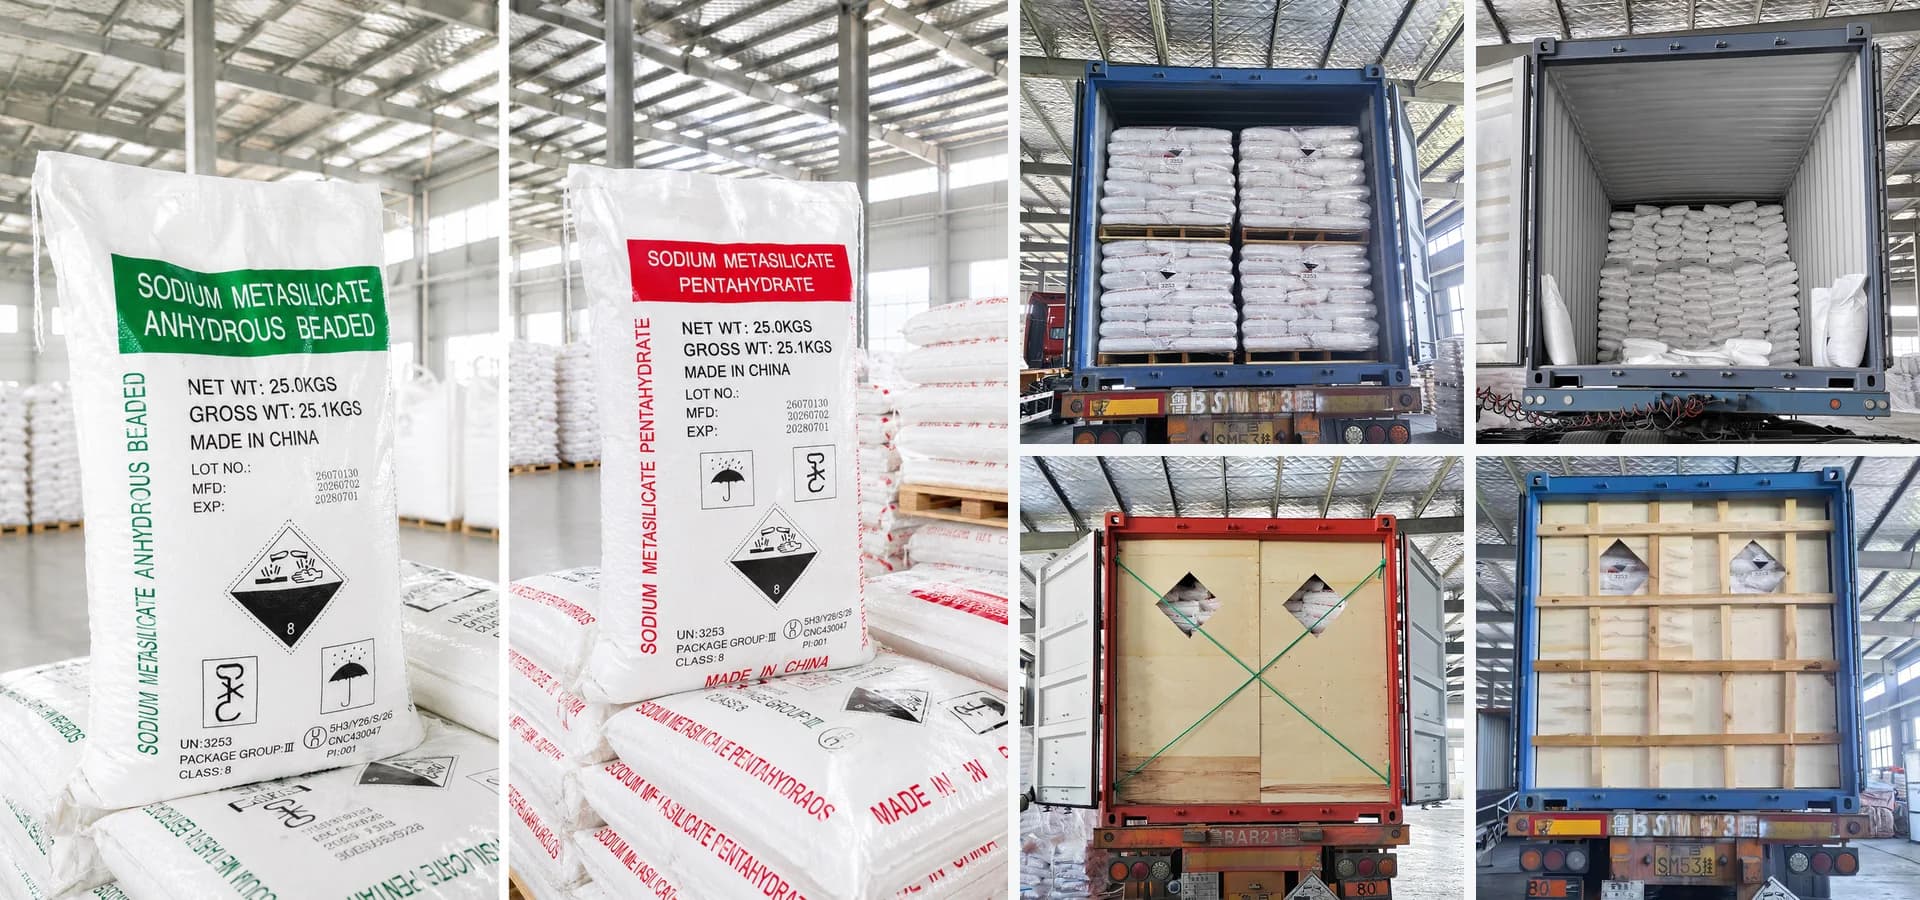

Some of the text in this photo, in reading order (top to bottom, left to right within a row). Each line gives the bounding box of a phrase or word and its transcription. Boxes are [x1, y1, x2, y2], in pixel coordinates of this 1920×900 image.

[648, 250, 836, 269] SODIUM METASILICATE
[137, 272, 373, 310] SODIUM METASILICATE
[679, 277, 815, 293] PENTAHYDRATE
[144, 309, 376, 343] ANHYDROUS BEADED
[682, 320, 813, 335] NET WT: 25.0KGS
[683, 340, 833, 357] GROSS WT: 25.1KGS
[684, 363, 791, 379] MADE IN CHINA
[188, 376, 337, 395] NET WT: 25.0KGS
[685, 388, 740, 400] LOT NO.:
[189, 400, 362, 423] GROSS WT: 25.1KGS
[686, 407, 719, 418] MFD:
[686, 425, 719, 438] EXP:
[190, 430, 320, 450] MADE IN CHINA
[191, 462, 251, 475] LOT NO.:
[192, 483, 227, 495] MFD:
[634, 317, 657, 655] SODIUM METASILICATE PENTAHYDRATE
[193, 501, 225, 513] EXP:
[123, 372, 160, 756] SODIUM METASILICATE ANHYDROUS BEADED
[773, 584, 780, 595] 8
[287, 623, 295, 635] 8
[676, 640, 728, 653] PACKAGE
[705, 655, 829, 688] MADE IN CHINA
[328, 725, 382, 746] CNC430047
[636, 701, 675, 724] SODIUM
[666, 714, 736, 757] METASILICATE
[180, 751, 236, 765] PACKAGE
[870, 784, 931, 825] MADE
[930, 772, 956, 797] IN
[1358, 882, 1376, 895] 80
[1529, 881, 1549, 896] 80
